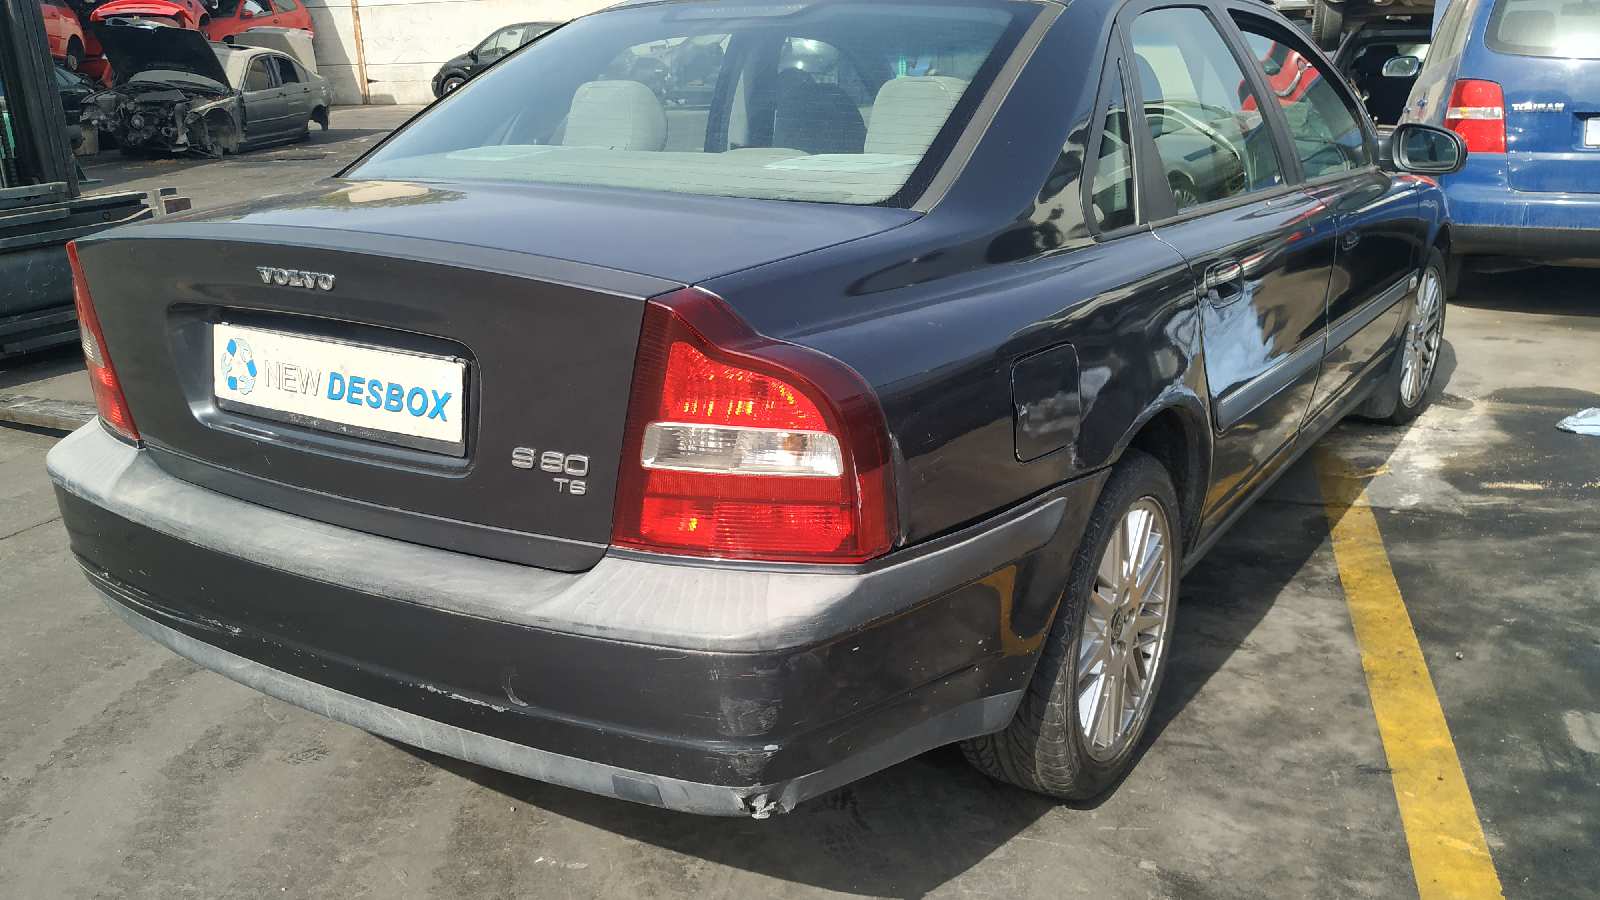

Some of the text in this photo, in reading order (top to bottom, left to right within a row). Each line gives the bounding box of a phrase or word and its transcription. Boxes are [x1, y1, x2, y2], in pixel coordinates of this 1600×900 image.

[256, 266, 336, 290] VOLVO
[264, 360, 452, 422] NEW DESBOX
[552, 477, 586, 495] T6
